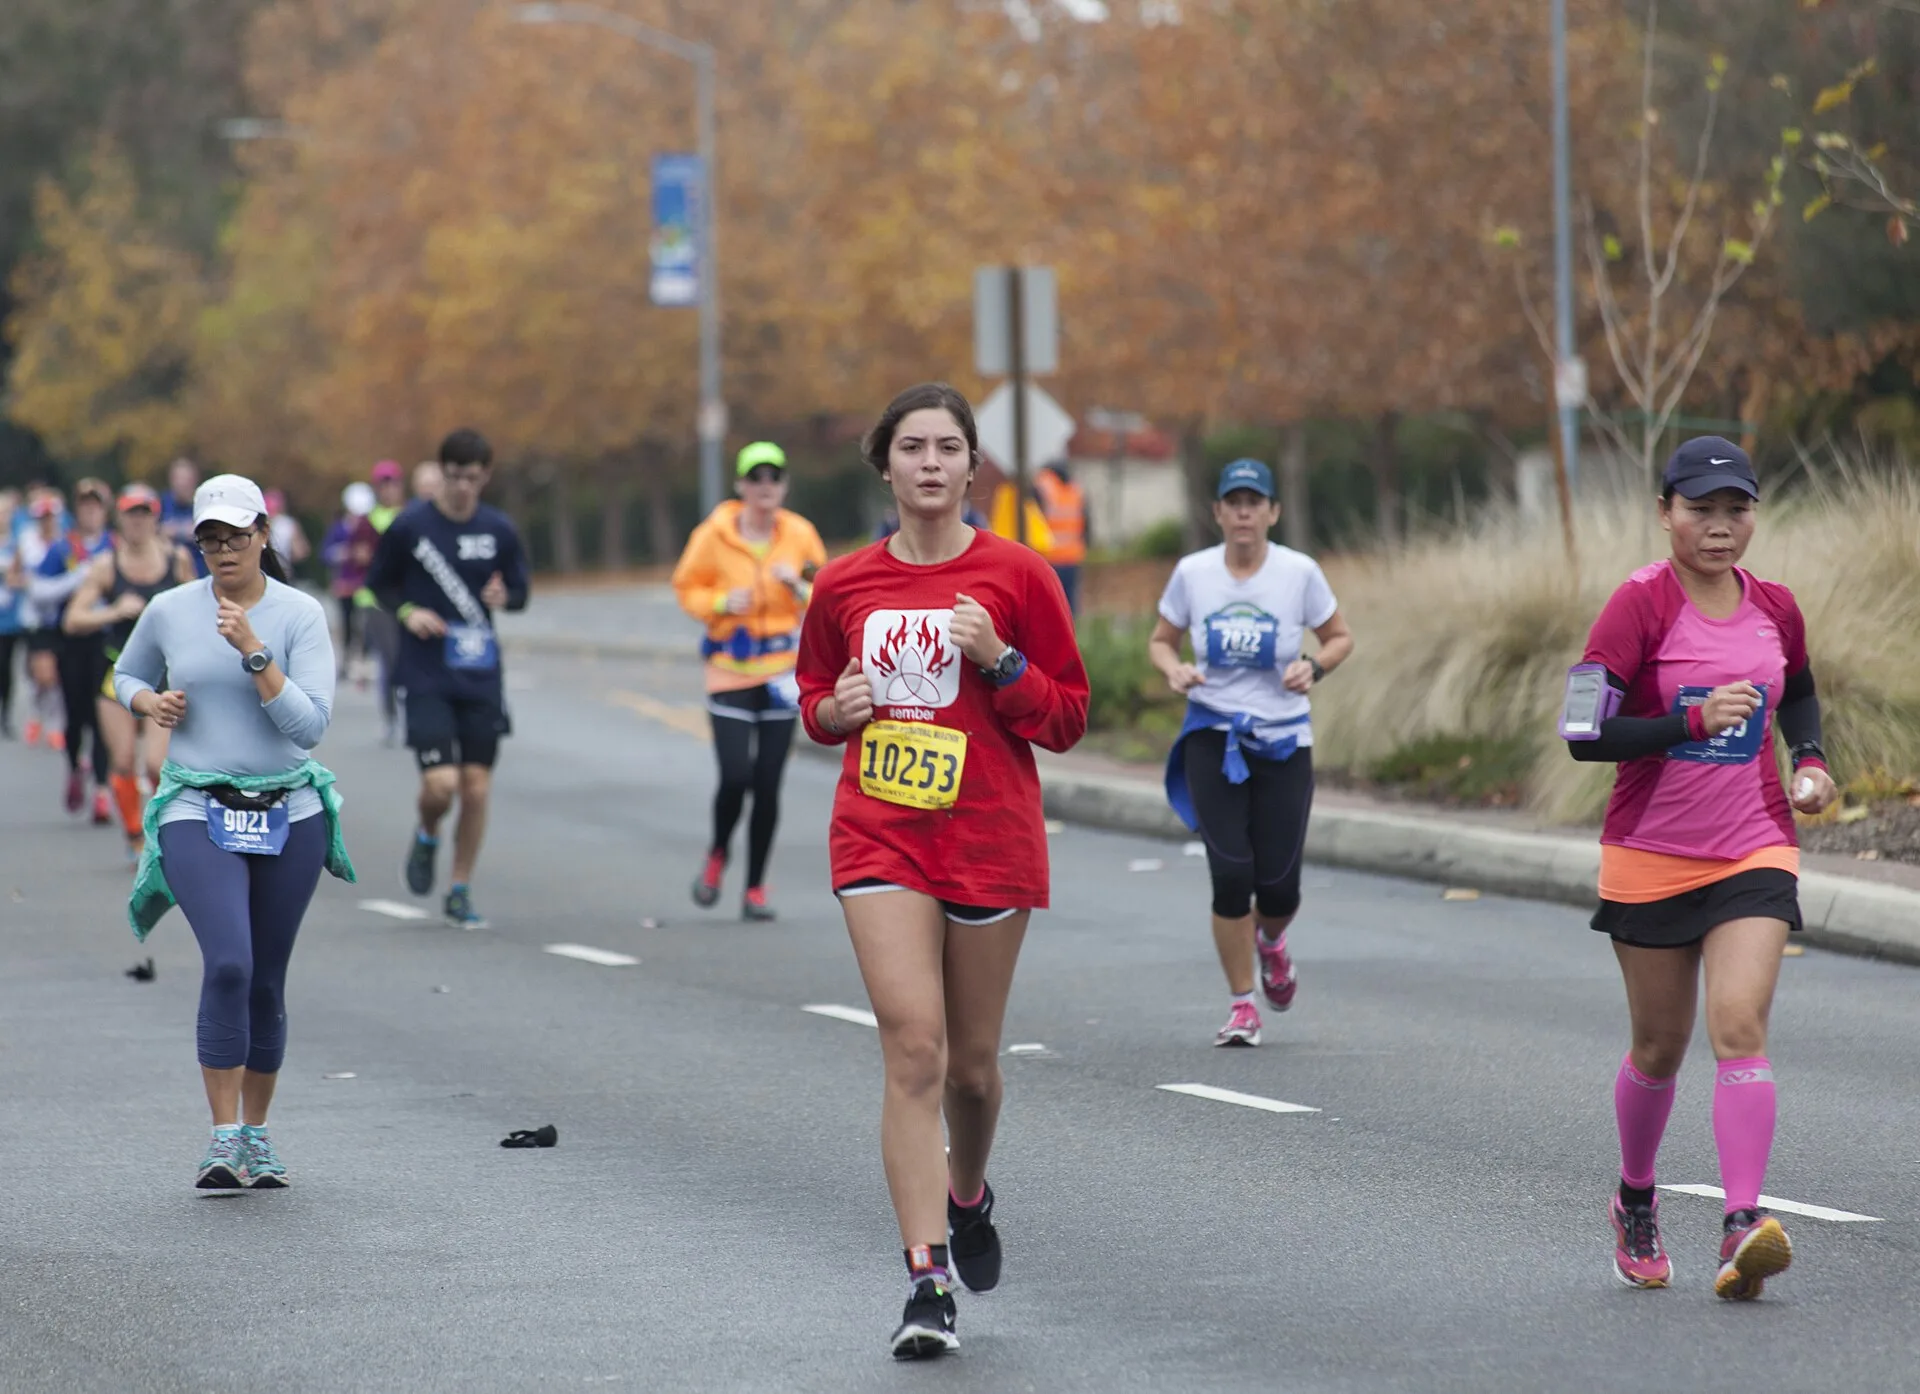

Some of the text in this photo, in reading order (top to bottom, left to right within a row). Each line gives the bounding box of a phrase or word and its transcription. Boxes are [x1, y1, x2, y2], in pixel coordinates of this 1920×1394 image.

[1709, 737, 1728, 747] SUE
[863, 739, 958, 794] 10253
[223, 808, 270, 834] 9021
